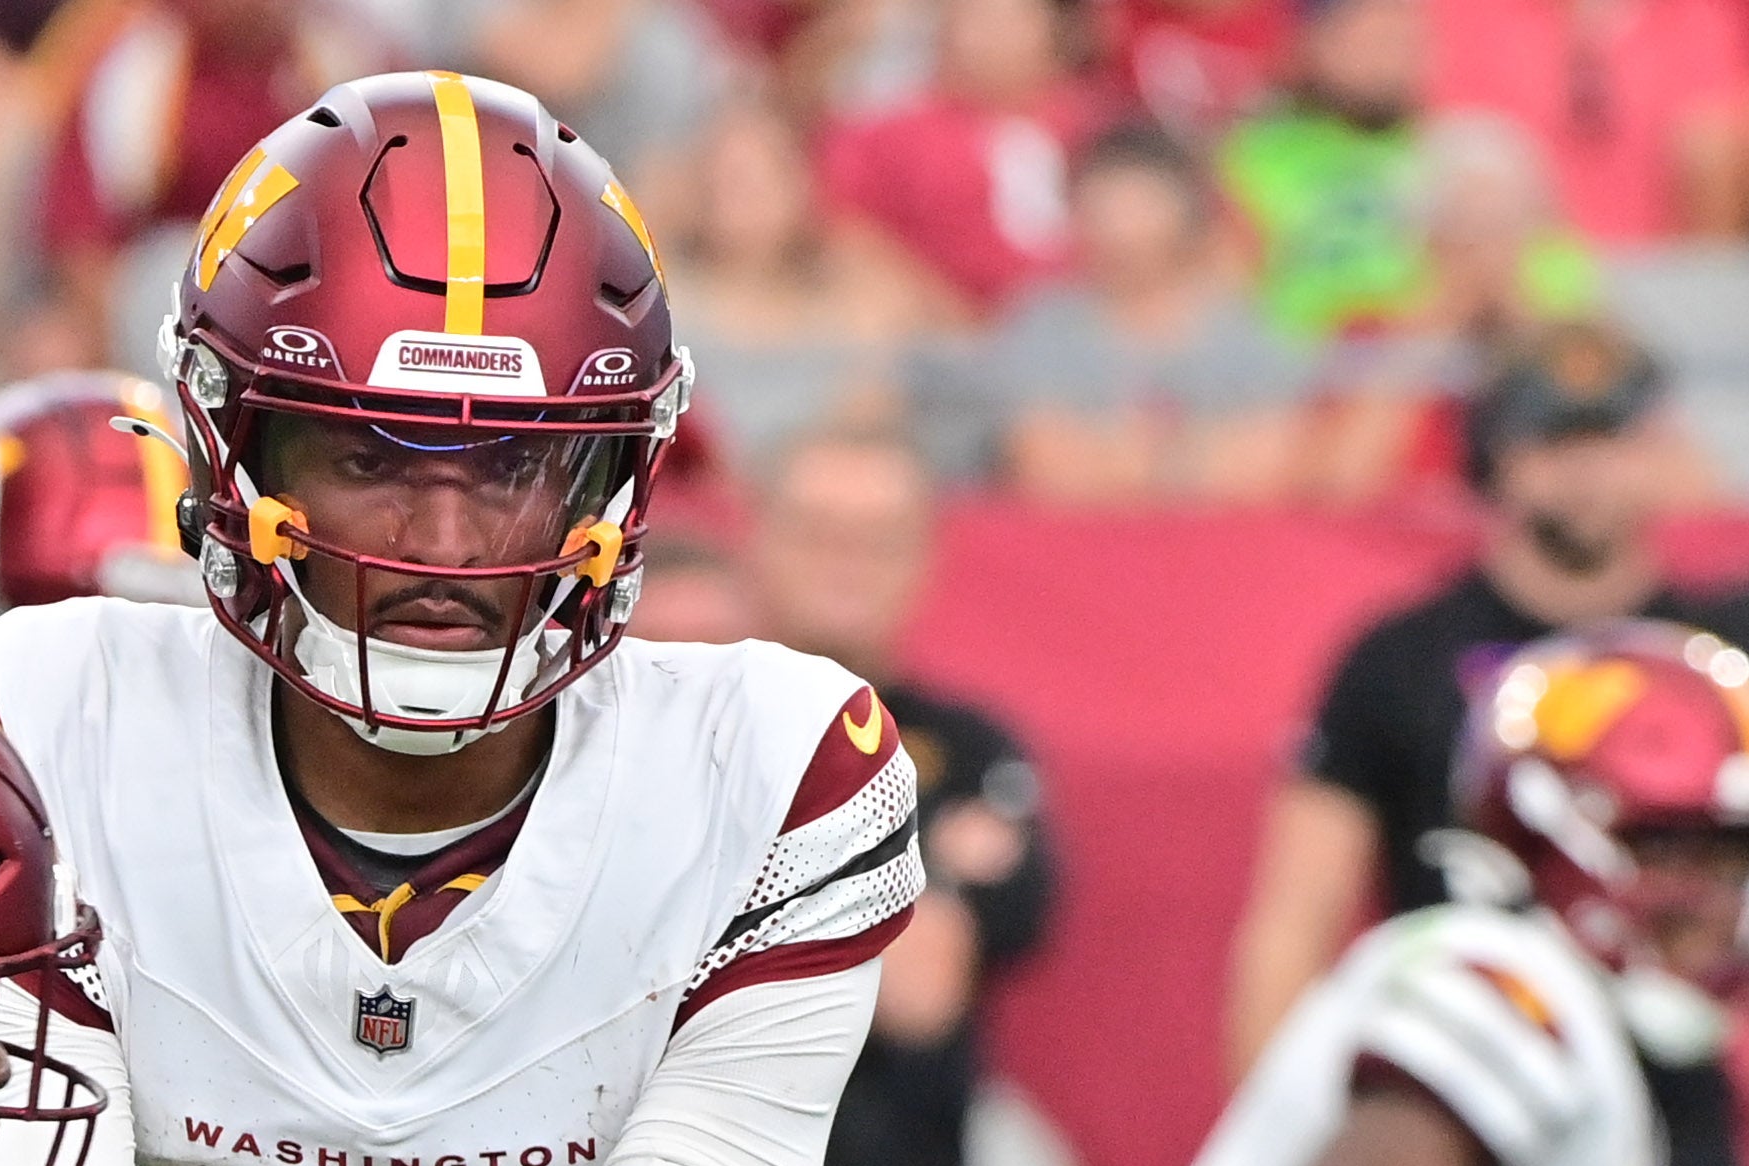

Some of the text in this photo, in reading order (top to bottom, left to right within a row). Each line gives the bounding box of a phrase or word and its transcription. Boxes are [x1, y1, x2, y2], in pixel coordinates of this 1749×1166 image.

[263, 347, 332, 368] OAKLEY
[398, 345, 523, 373] COMMANDERS
[582, 373, 638, 386] OAKLEY
[362, 1015, 404, 1046] NFL
